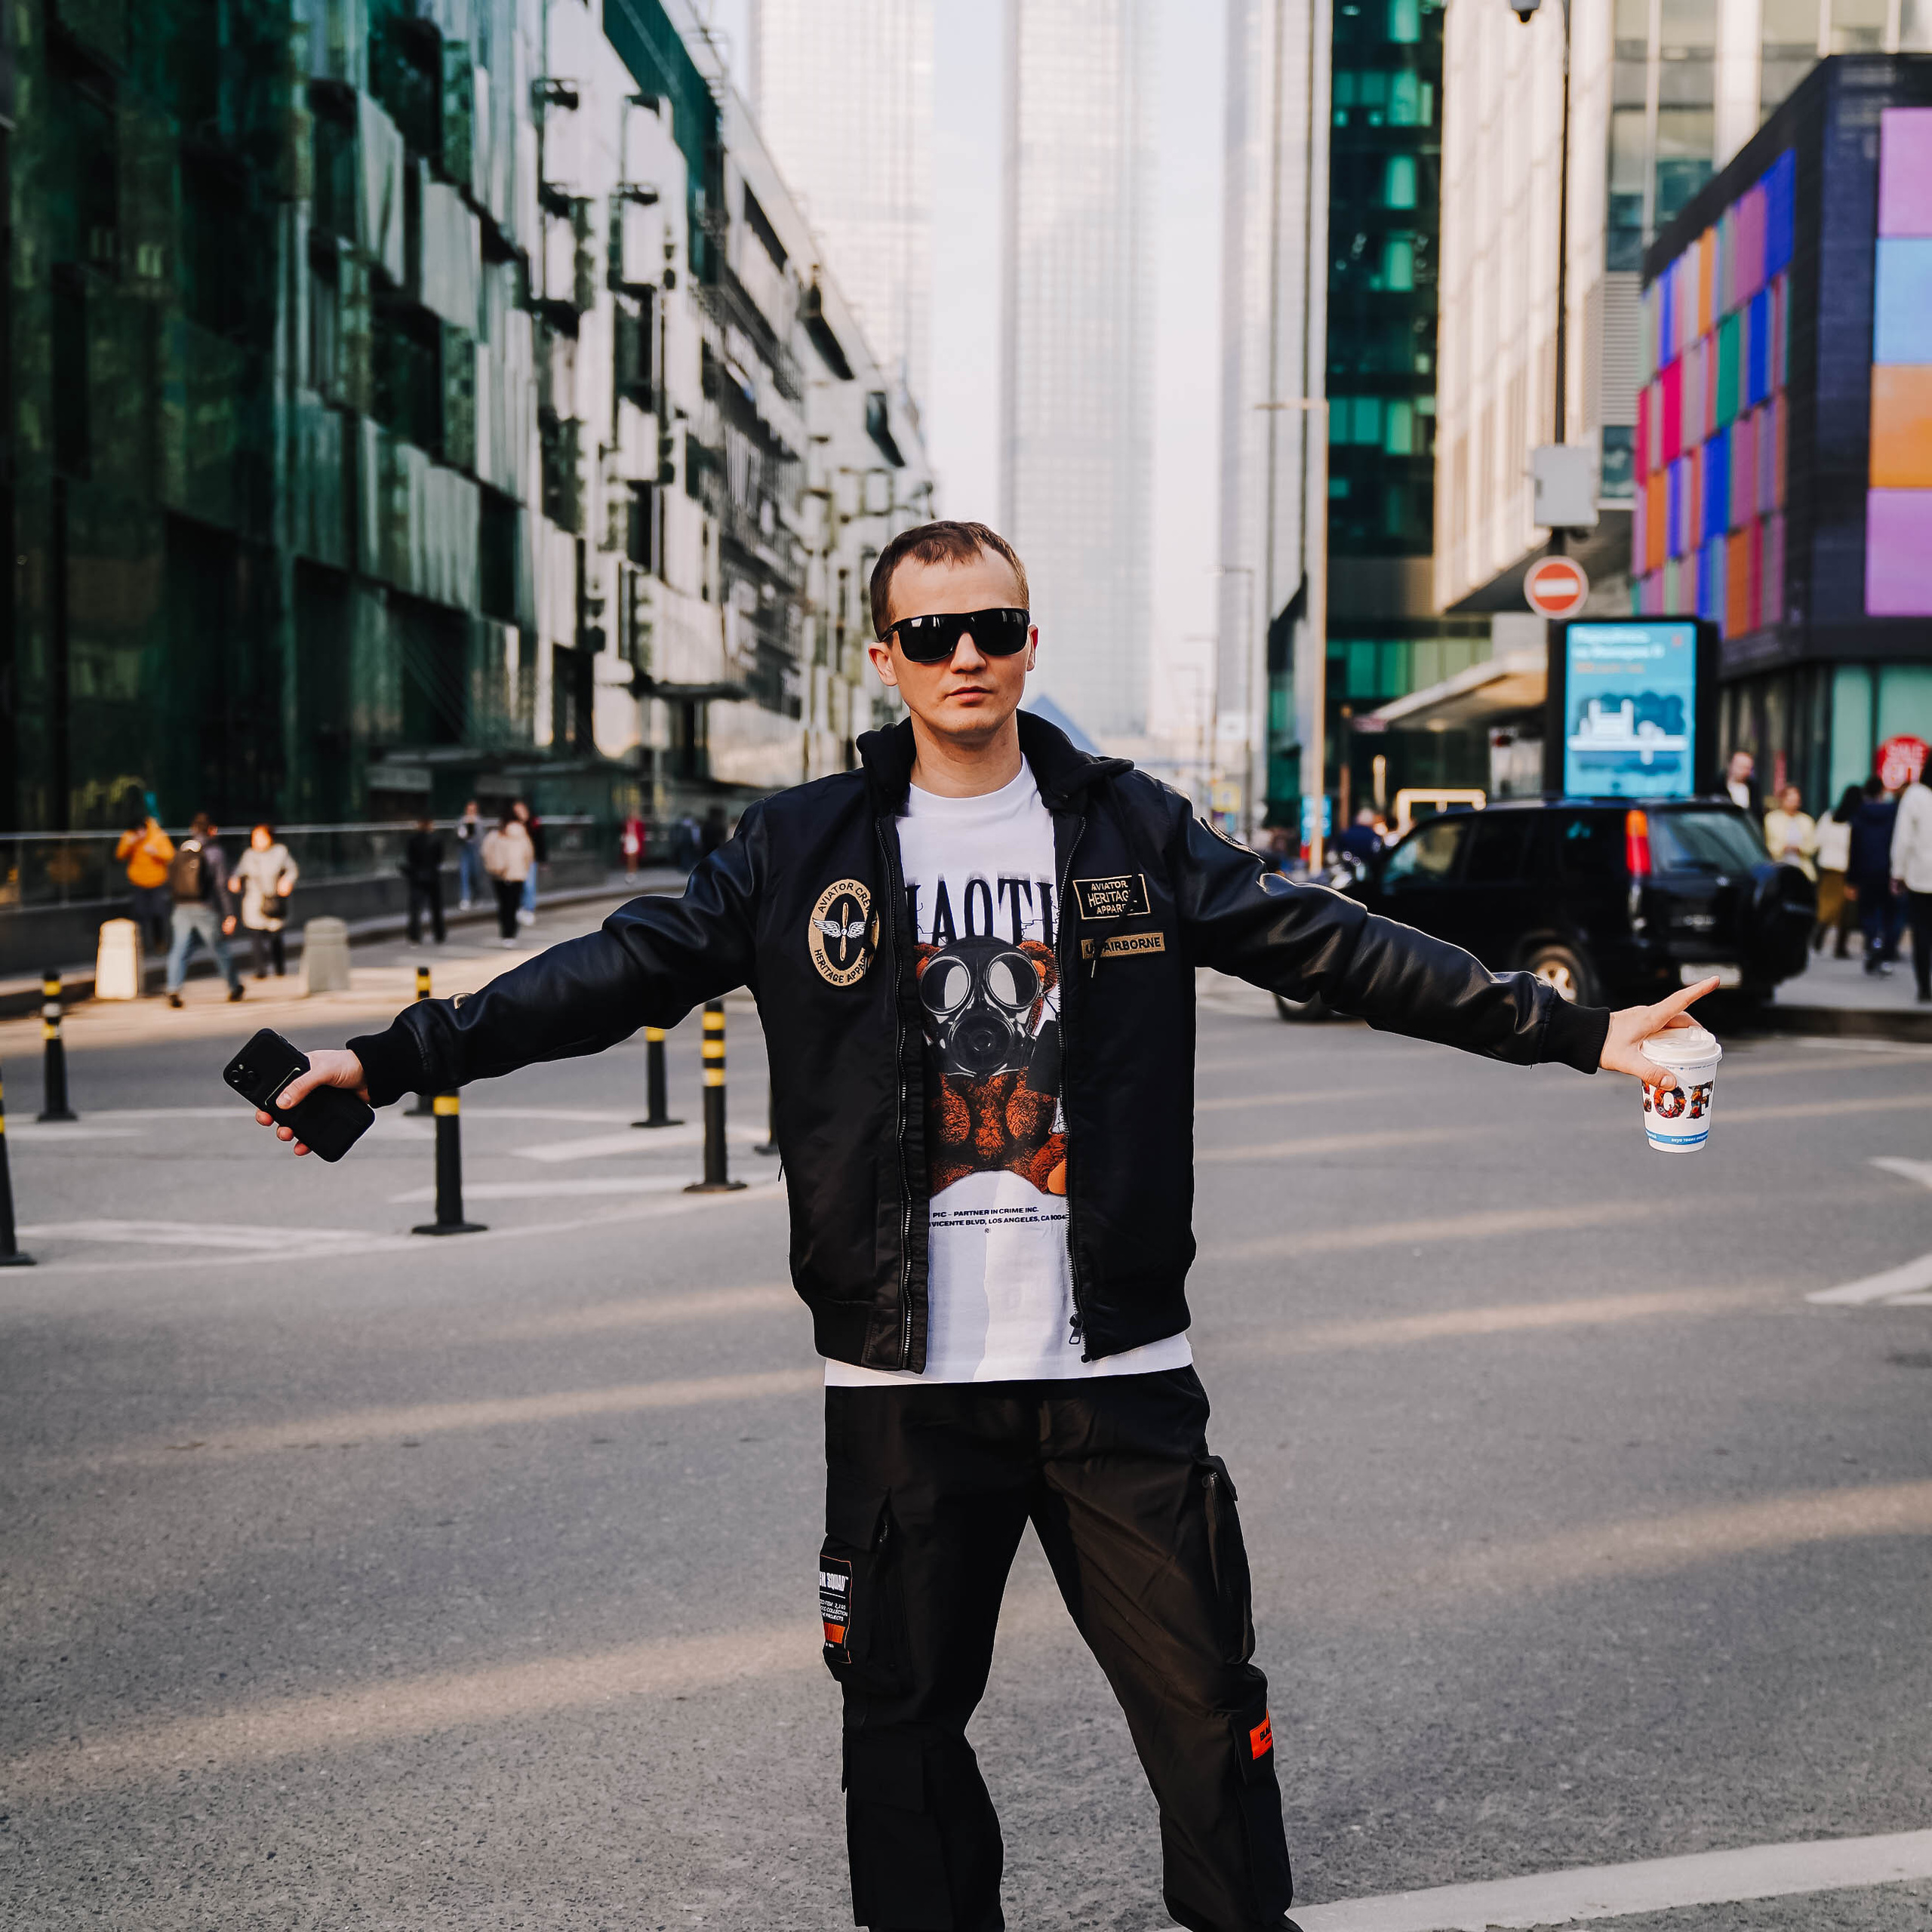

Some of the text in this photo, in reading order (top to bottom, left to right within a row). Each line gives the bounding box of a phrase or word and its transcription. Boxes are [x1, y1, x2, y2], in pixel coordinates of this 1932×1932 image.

[1091, 880, 1129, 891] AVIATOR
[818, 882, 854, 913] AVIATOR
[1088, 890, 1133, 908] HERITAG
[1103, 937, 1161, 952] AIRBORNE
[814, 949, 844, 983] HERITAGE
